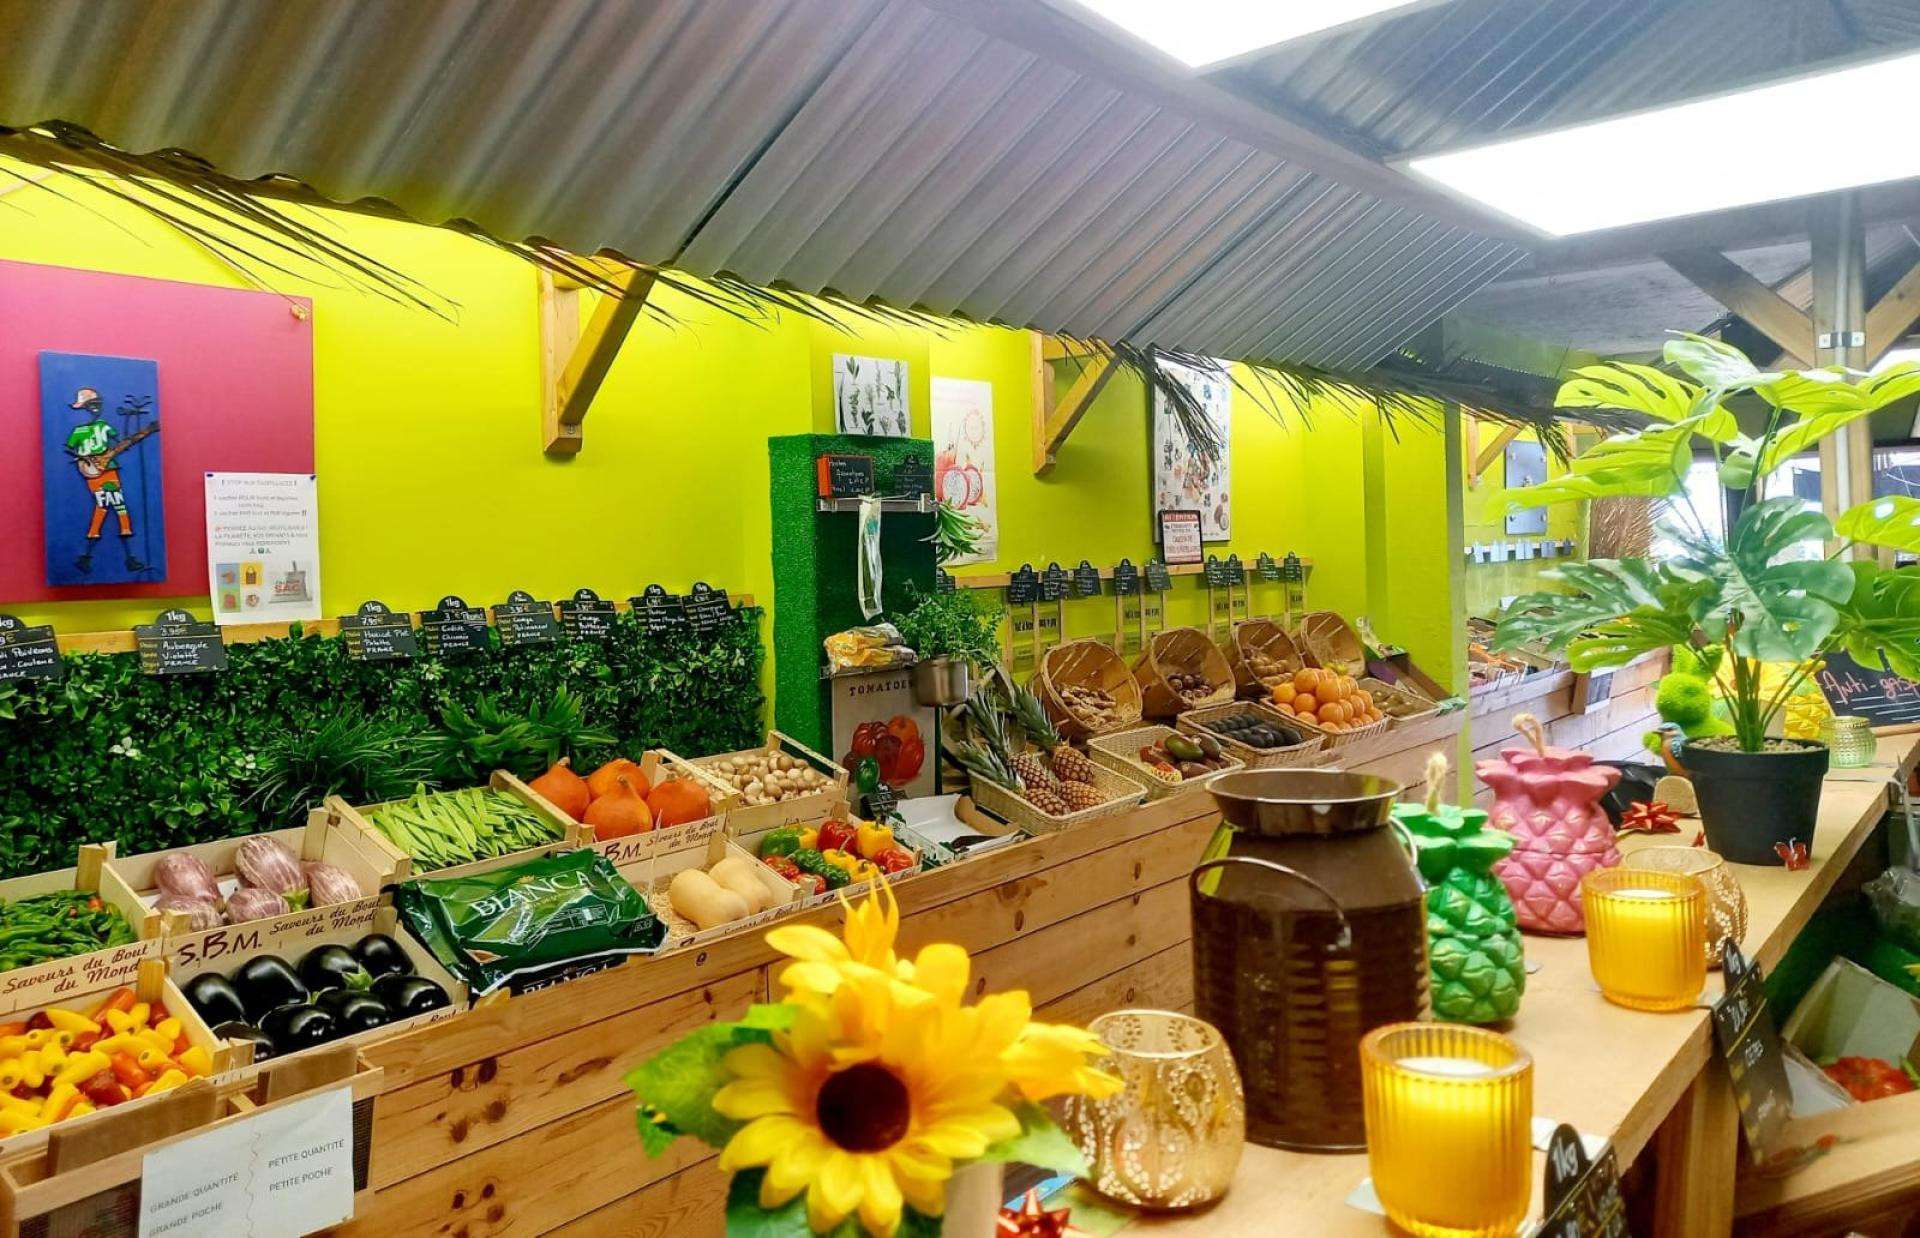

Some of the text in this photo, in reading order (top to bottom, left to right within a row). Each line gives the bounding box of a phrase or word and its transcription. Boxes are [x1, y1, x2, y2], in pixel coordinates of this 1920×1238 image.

[166, 610, 187, 622] 1kg
[469, 870, 596, 918] BIANCA
[269, 914, 324, 936] Saveurs
[329, 905, 346, 920] du
[305, 924, 326, 938] du
[177, 929, 263, 967] S.B.M.
[2, 943, 149, 995] Saveurs du Bout
[53, 958, 141, 994] du Mond
[268, 1154, 300, 1169] PETITE
[1553, 1135, 1580, 1183] 1kg
[269, 1166, 333, 1192] PETITE POCHE
[150, 1192, 190, 1214] GRANDE
[191, 1201, 224, 1220] POCHE
